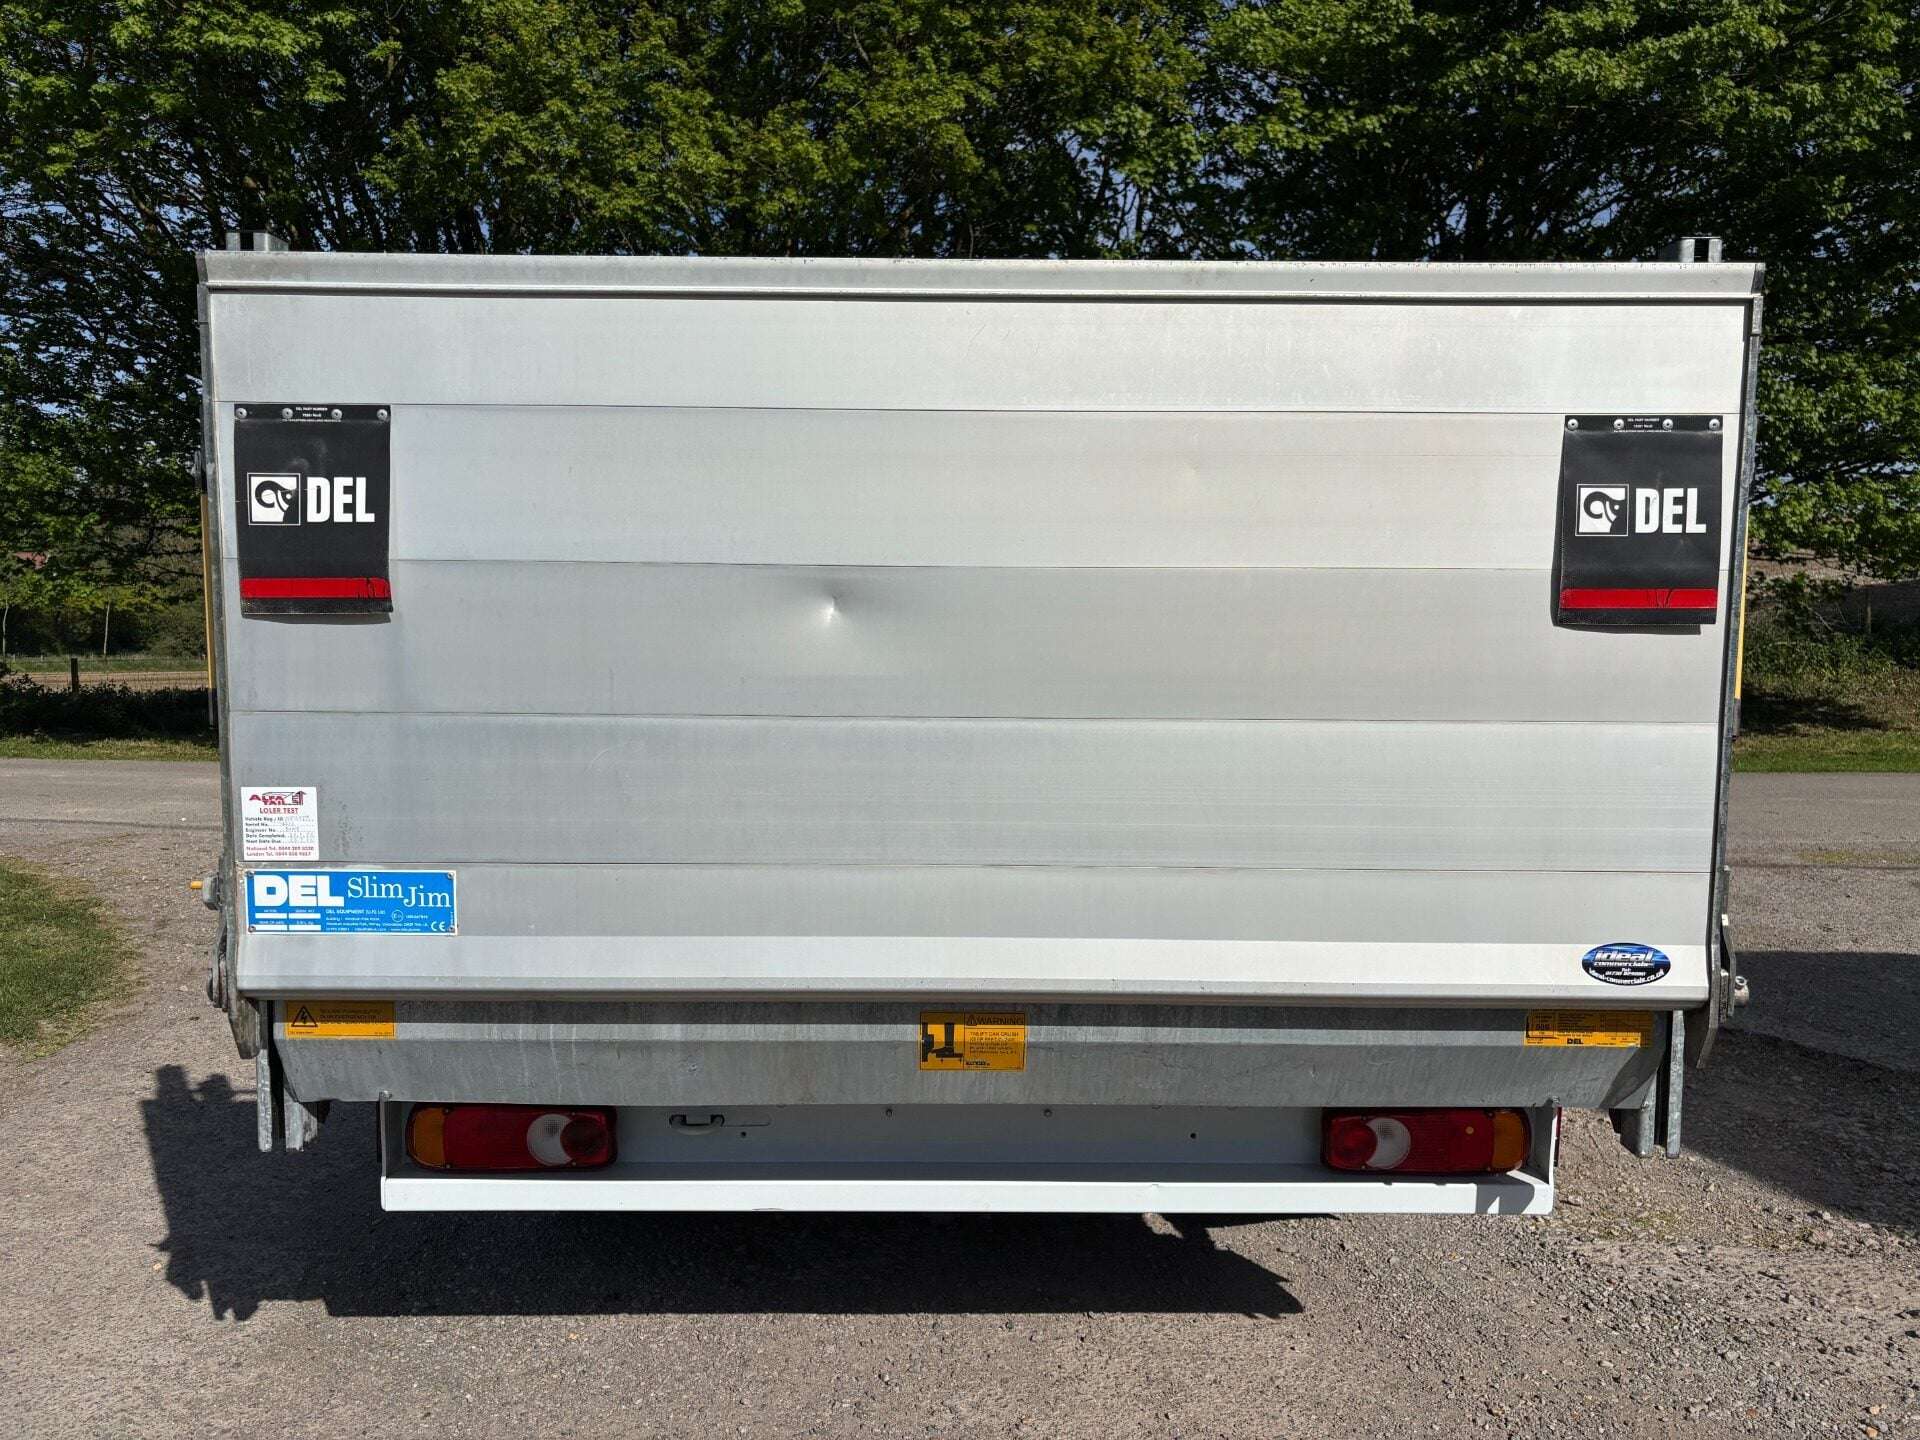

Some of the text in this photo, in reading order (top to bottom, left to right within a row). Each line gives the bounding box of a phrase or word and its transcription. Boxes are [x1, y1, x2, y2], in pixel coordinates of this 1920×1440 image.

[306, 476, 376, 523] DEL
[1635, 488, 1706, 534] DEL
[254, 875, 344, 907] DEL
[348, 875, 451, 908] Slim Jim
[1594, 950, 1654, 962] ideal
[977, 1016, 1024, 1025] WARNING
